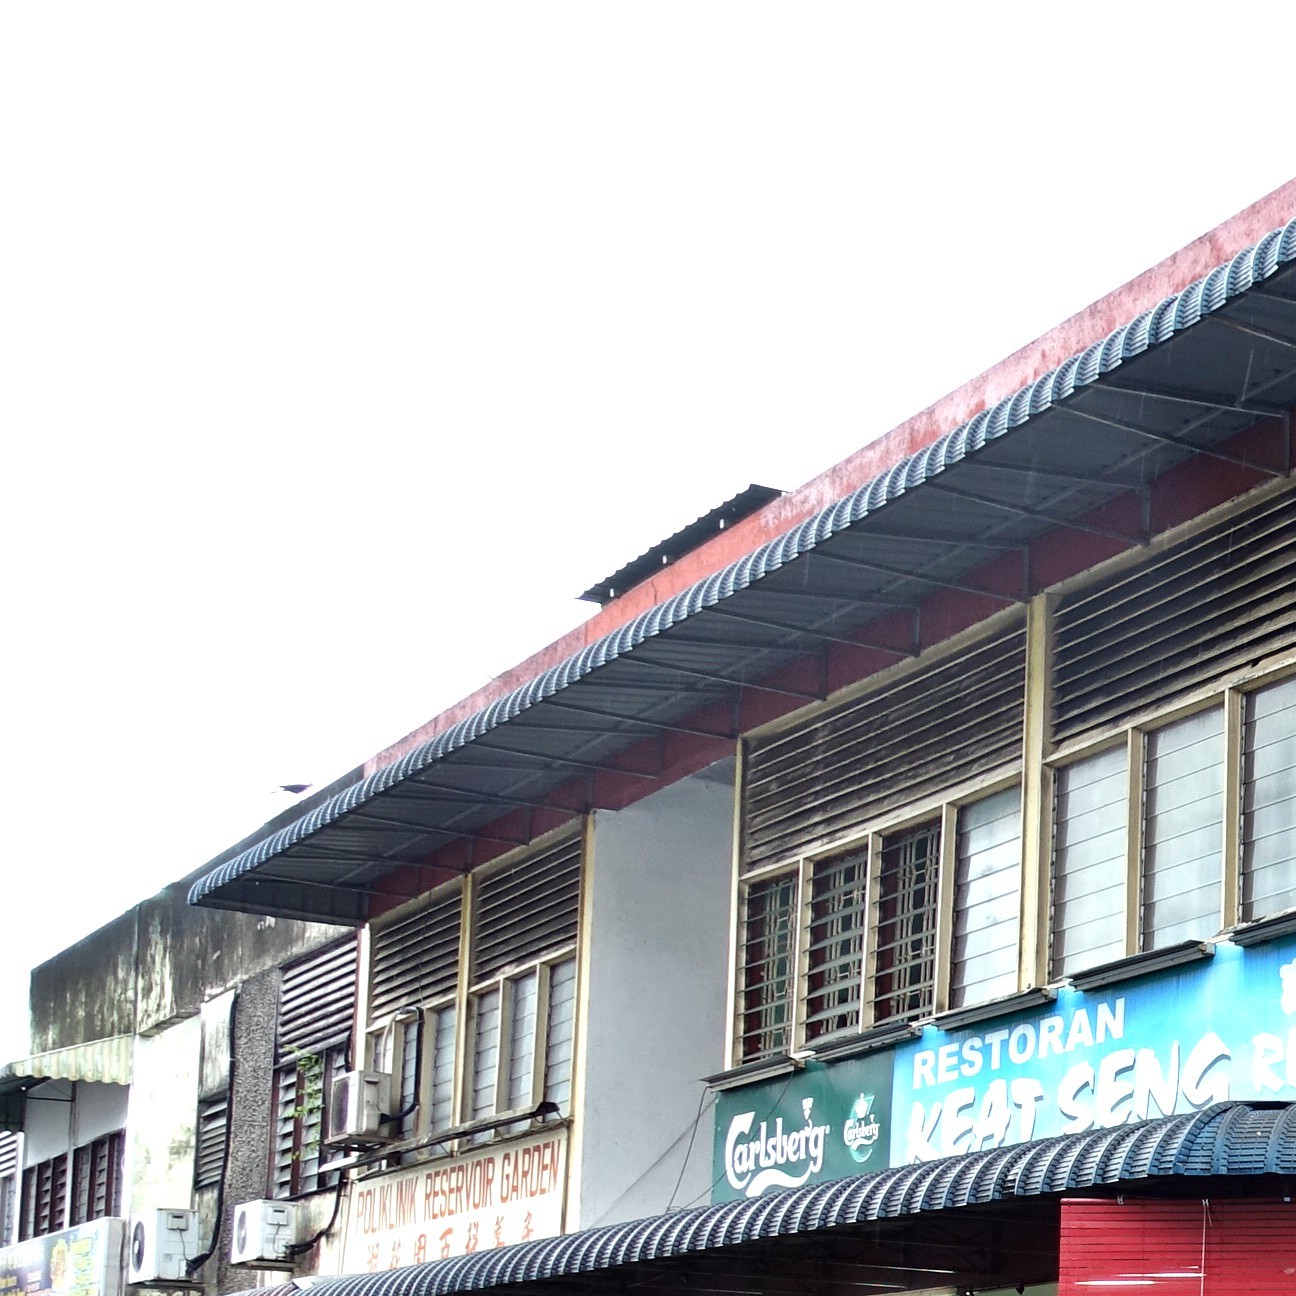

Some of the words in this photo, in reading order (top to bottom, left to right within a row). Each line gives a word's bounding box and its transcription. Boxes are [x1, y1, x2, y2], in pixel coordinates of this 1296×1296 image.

[912, 998, 1125, 1089] RESTORAN
[843, 1114, 880, 1151] Carlsberg
[907, 1077, 1043, 1165] KEAT
[1058, 1032, 1231, 1135] SENG
[356, 1176, 419, 1236] POLIKLINIK
[424, 1156, 495, 1222] RESERVOIR
[500, 1139, 561, 1204] GARDEN
[726, 1098, 829, 1197] Carlsberg
